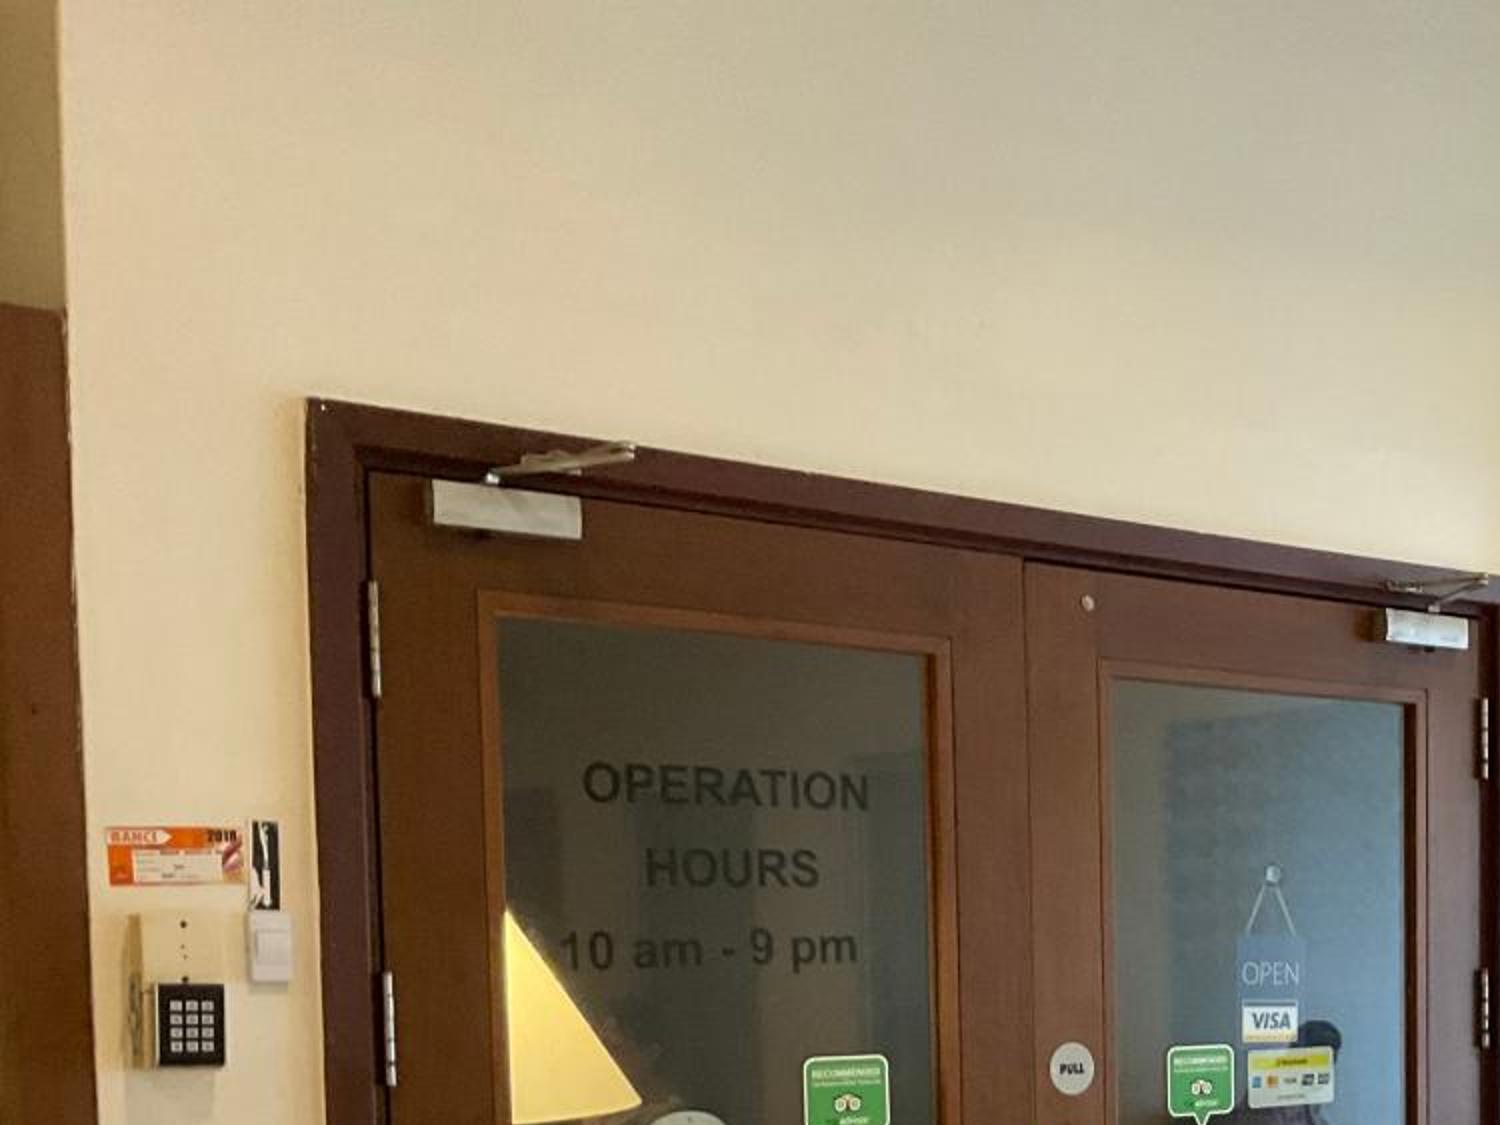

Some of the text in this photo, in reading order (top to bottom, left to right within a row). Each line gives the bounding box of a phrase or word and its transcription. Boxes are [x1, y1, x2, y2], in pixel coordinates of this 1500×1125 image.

[583, 761, 869, 811] OPERATION
[645, 848, 820, 889] HOURS
[560, 931, 614, 971] 10
[633, 937, 701, 970] am
[750, 928, 773, 967] 9
[791, 932, 857, 973] pm
[1242, 961, 1299, 986] OPEN
[1252, 1012, 1291, 1030] VISA
[1059, 1062, 1085, 1075] PULL
